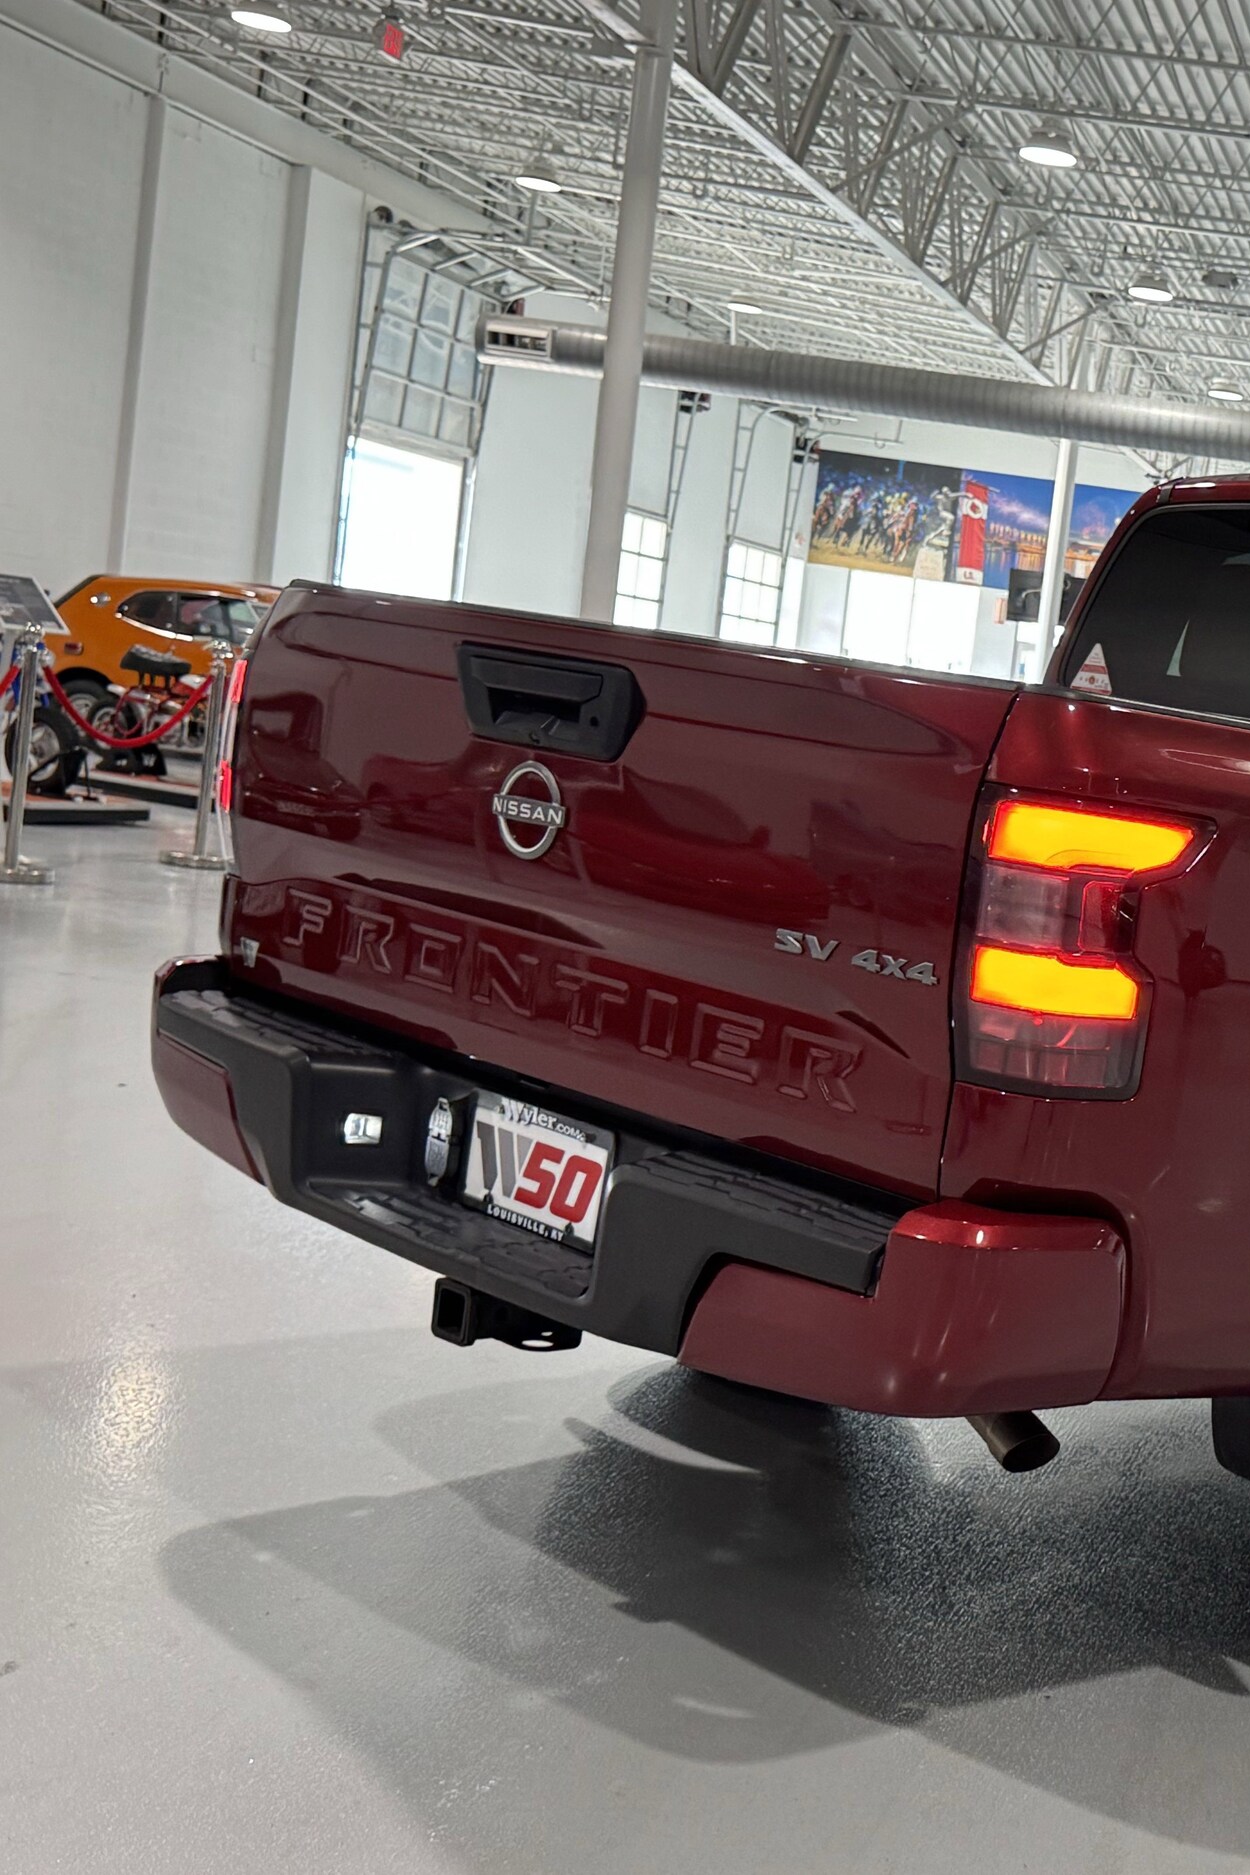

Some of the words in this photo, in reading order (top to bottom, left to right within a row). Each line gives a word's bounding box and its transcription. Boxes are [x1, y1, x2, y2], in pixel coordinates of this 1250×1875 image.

[493, 796, 563, 825] NISSAN
[774, 928, 840, 961] SV
[281, 885, 862, 1114] FRONTIER
[487, 1203, 549, 1237] LOUISVILLE,
[550, 1228, 564, 1242] KY
